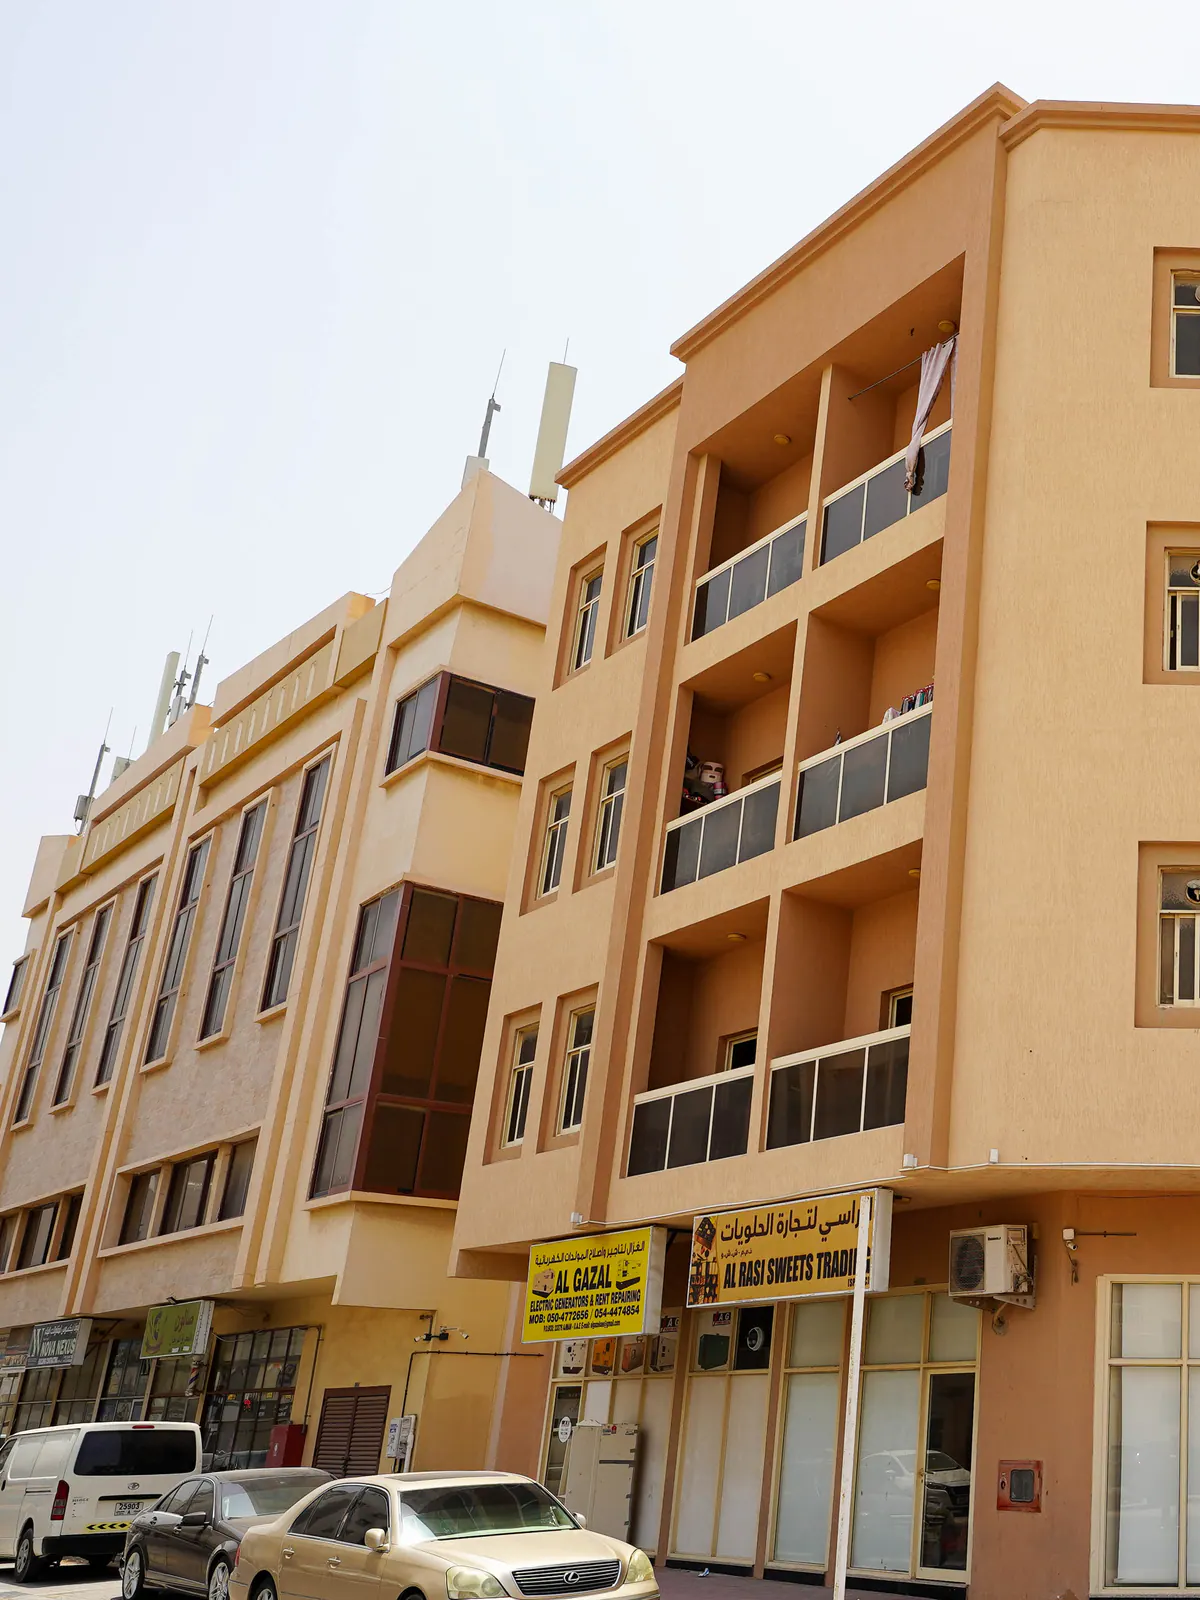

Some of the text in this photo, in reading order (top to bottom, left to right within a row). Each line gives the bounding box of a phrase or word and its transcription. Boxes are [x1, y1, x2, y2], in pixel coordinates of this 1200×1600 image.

[720, 1197, 872, 1245] اراسي لتجارة الحلويات
[626, 1240, 645, 1256] الغزال
[555, 1264, 612, 1294] AL GAZAL
[723, 1246, 871, 1289] AL RASI SWEETS TRADI
[530, 1299, 554, 1312] ELECTRIC
[554, 1295, 589, 1310] GENERATORS
[595, 1293, 610, 1306] RENT
[529, 1314, 546, 1324] MOB:
